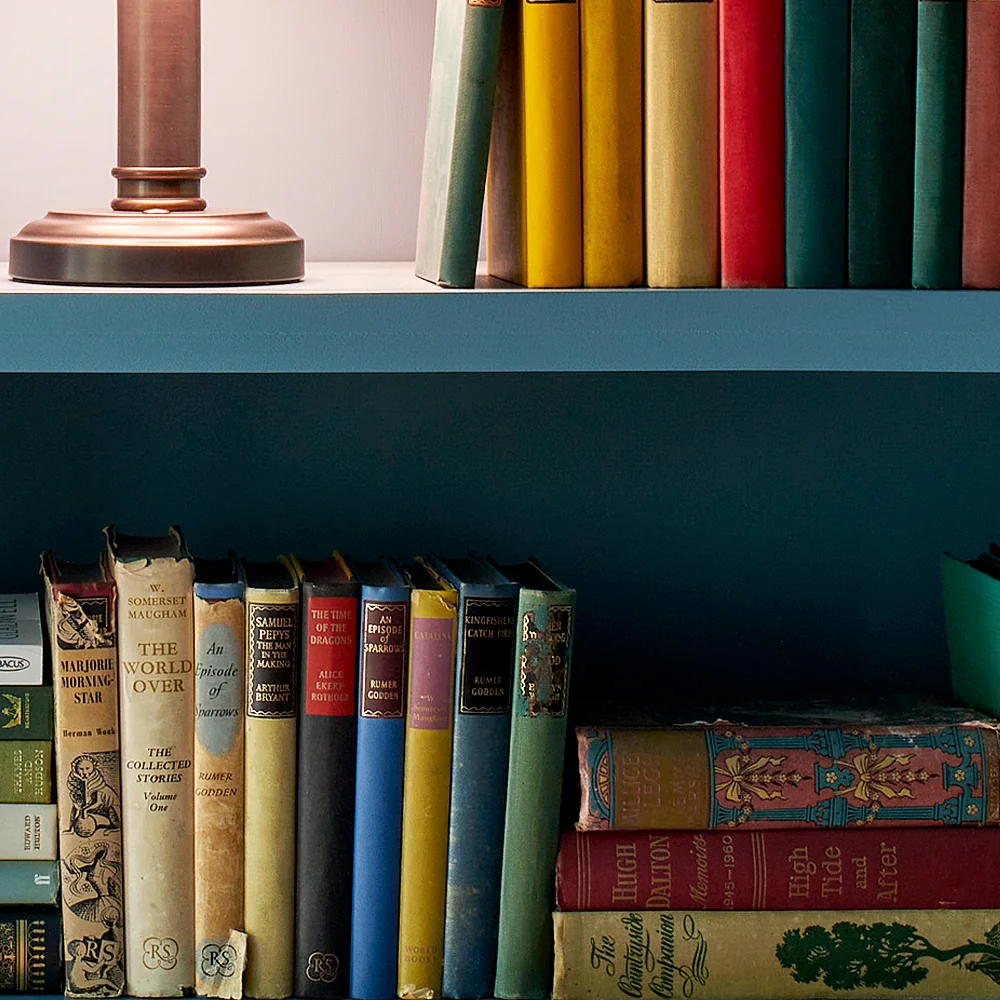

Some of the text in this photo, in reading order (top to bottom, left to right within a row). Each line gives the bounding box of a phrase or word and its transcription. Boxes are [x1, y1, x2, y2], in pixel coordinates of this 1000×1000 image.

[128, 597, 186, 605] SOMERSET
[128, 610, 187, 619] MAUGHAM
[256, 617, 293, 628] SAMUEL
[311, 636, 352, 644] DRAGONS
[138, 643, 178, 656] THE
[207, 643, 224, 654] An
[61, 659, 113, 672] MARJORIE
[123, 661, 192, 675] WORLD
[257, 660, 290, 668] MAKING
[133, 680, 184, 693] OVER
[209, 682, 227, 700] of
[74, 692, 103, 704] STAR
[256, 693, 290, 702] BRYANT
[148, 748, 171, 757] THE
[127, 760, 191, 770] COLLECTED
[136, 774, 182, 783] STORIES
[144, 792, 177, 801] Volume
[646, 835, 670, 908] DALTON
[789, 846, 816, 898] High
[821, 846, 842, 896] Tide
[852, 857, 867, 889] and
[877, 842, 897, 903] After
[591, 936, 615, 976] The
[618, 913, 656, 998] Countryside
[649, 914, 675, 998] Companion
